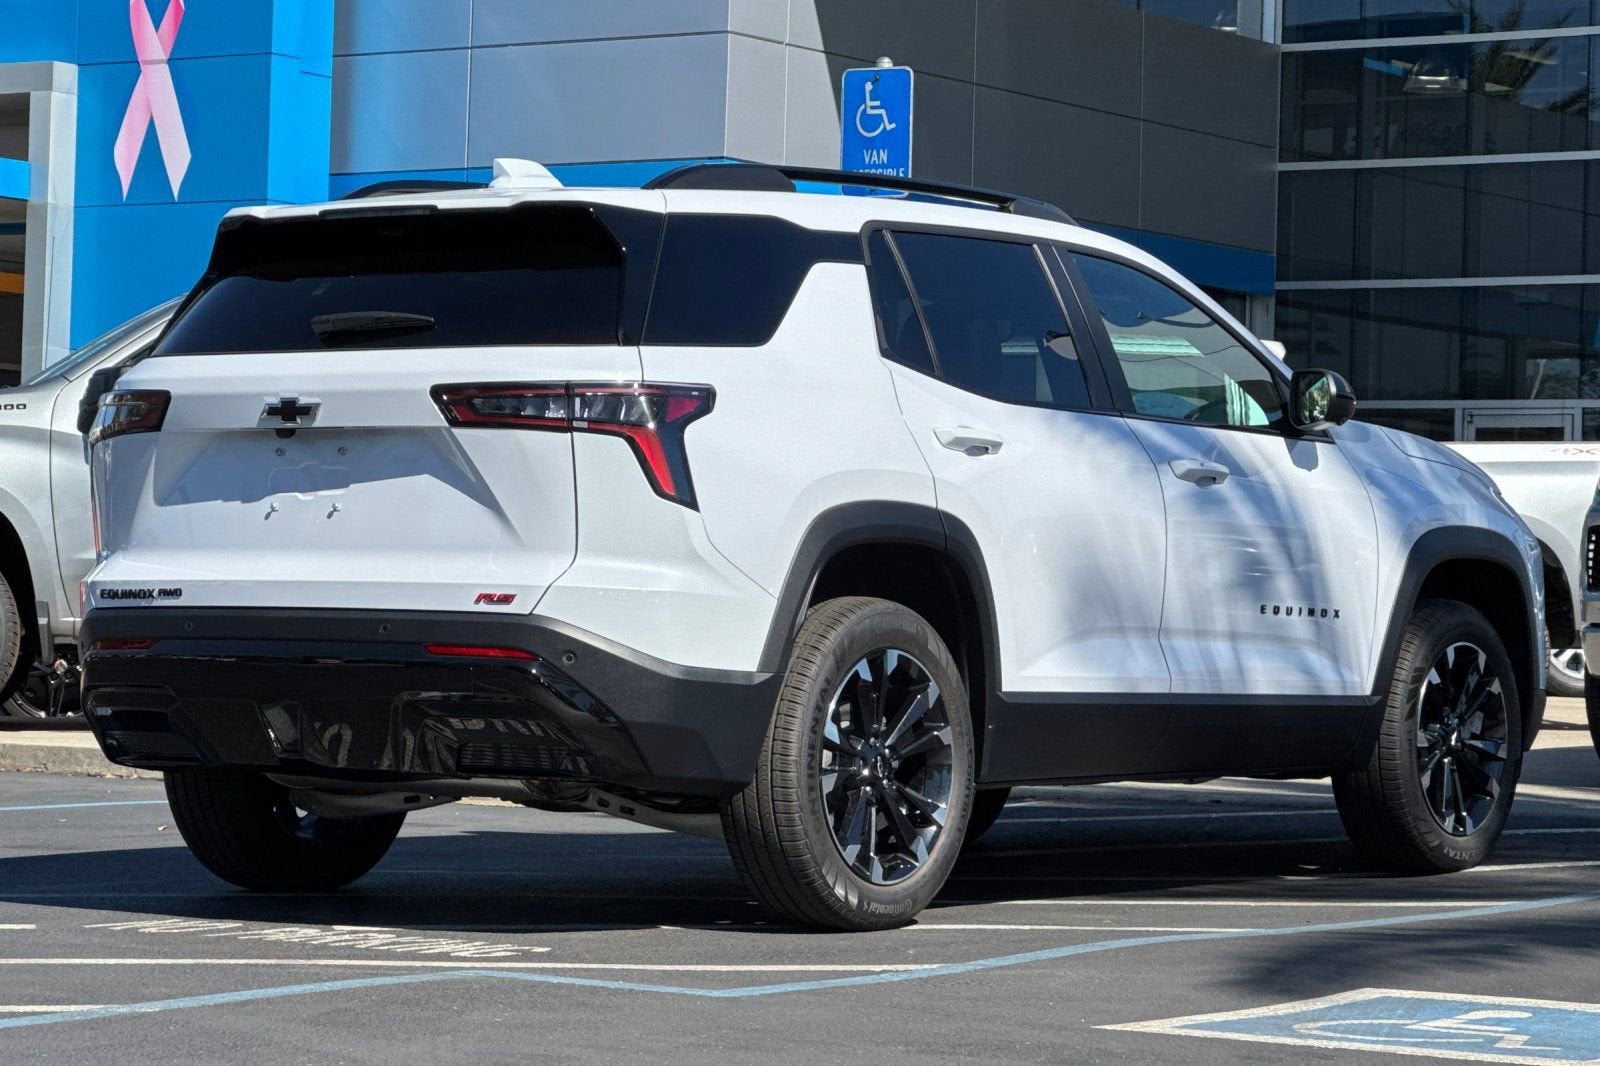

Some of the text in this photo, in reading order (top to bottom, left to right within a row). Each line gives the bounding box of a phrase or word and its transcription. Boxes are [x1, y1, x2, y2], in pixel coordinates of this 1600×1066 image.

[863, 149, 888, 165] VAN
[100, 587, 182, 600] EQUINOX AWD
[473, 593, 518, 605] RS
[1260, 604, 1340, 619] EQUINOX
[805, 675, 833, 832] NTINENTAL
[867, 898, 913, 915] Continental
[82, 918, 552, 958] NO PARKING
